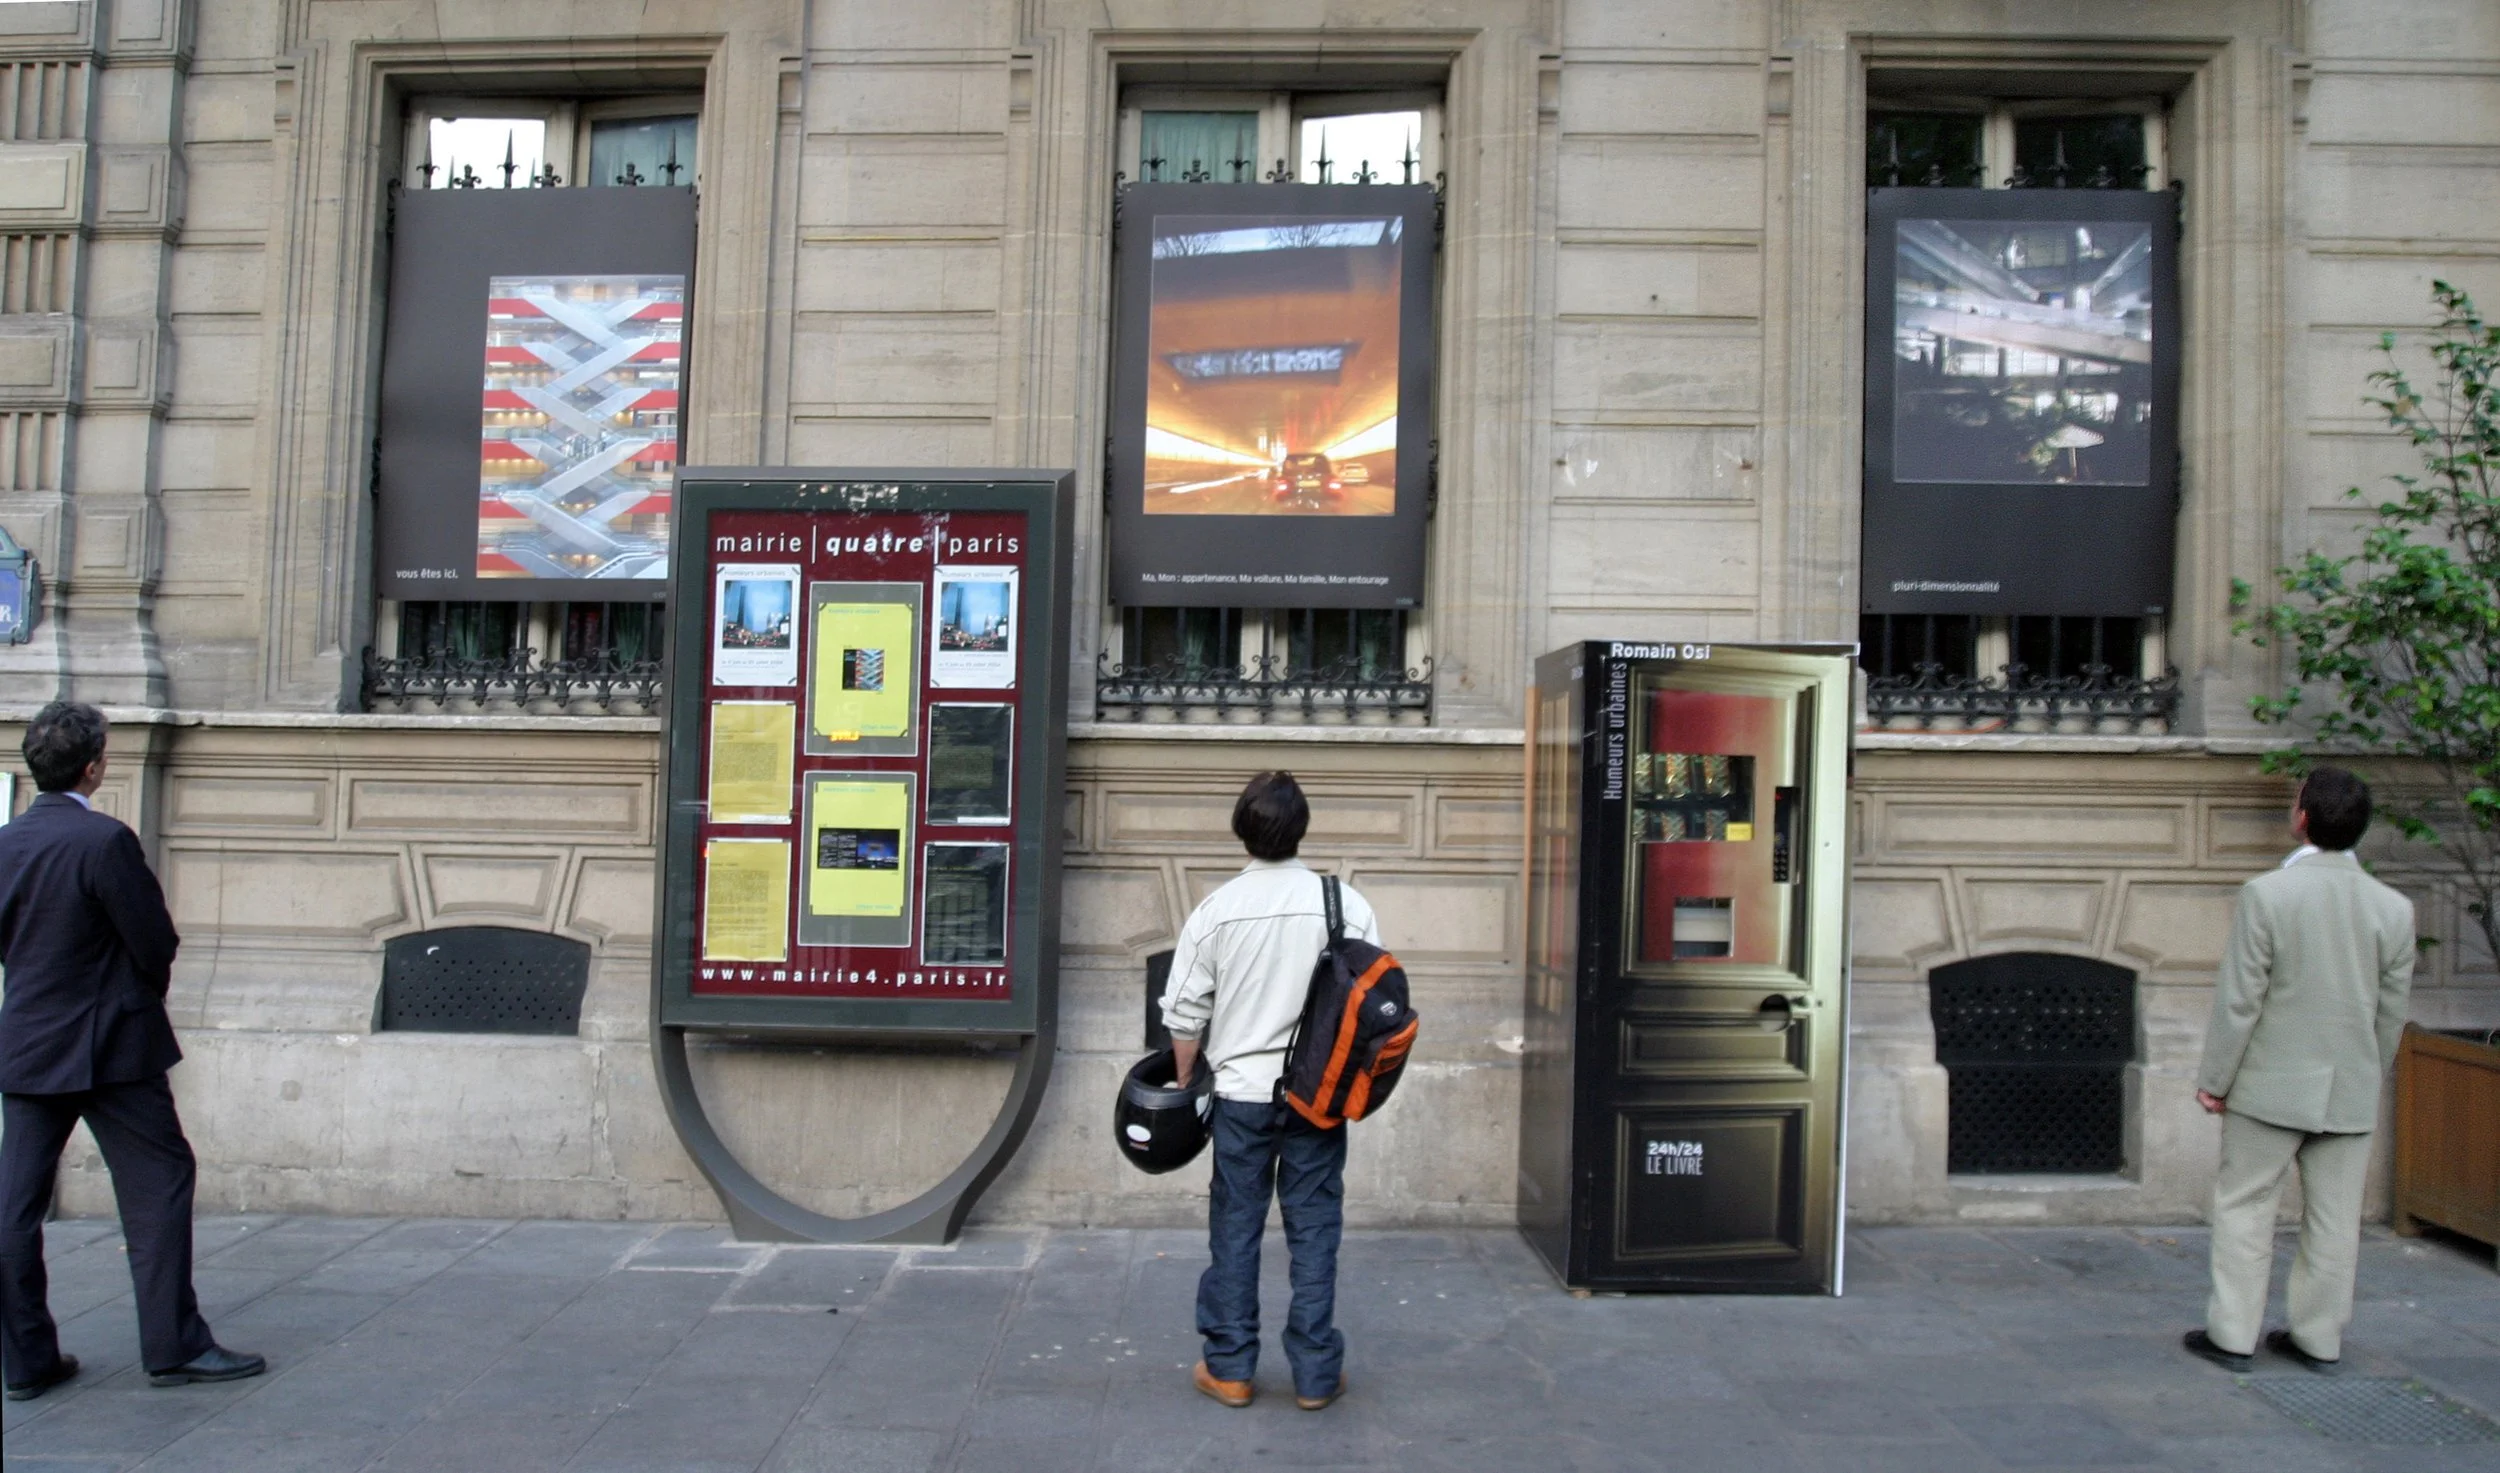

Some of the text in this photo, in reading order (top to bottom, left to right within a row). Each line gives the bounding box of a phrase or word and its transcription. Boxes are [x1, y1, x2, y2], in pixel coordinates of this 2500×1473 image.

[716, 531, 1019, 557] mairie quatre paris
[396, 567, 459, 579] vous êtes ici.
[1158, 573, 1176, 582] Mon
[1239, 574, 1252, 583] Ma
[1285, 575, 1298, 584] Ma
[1329, 575, 1347, 584] Mon
[1611, 643, 1711, 659] Romain Osi
[1603, 662, 1628, 800] Humeurs urbaines
[702, 968, 1006, 987] www.mairie4.paris.fr
[1648, 1141, 1703, 1157] 24h/24
[1646, 1156, 1704, 1176] LE LIVRE
